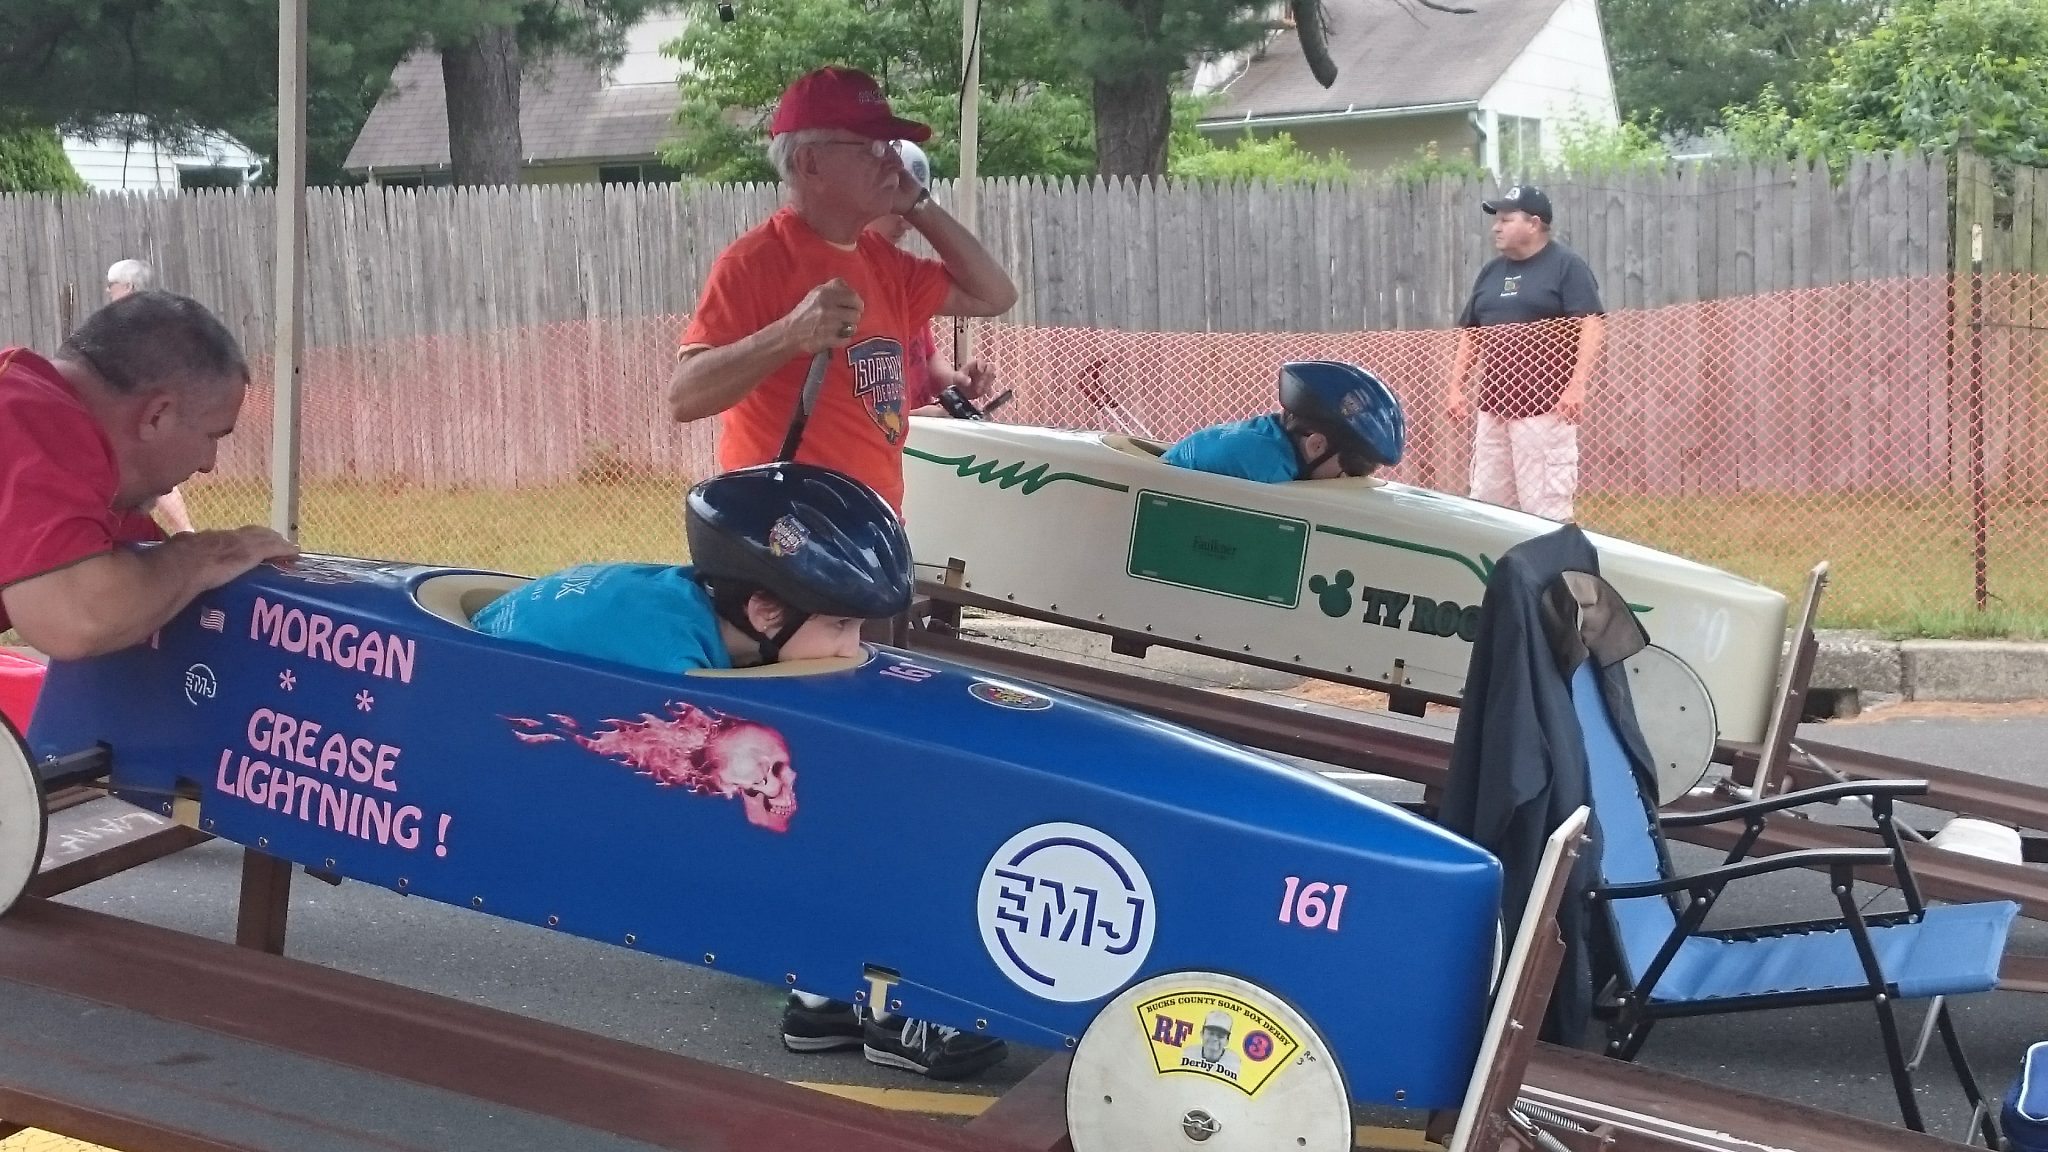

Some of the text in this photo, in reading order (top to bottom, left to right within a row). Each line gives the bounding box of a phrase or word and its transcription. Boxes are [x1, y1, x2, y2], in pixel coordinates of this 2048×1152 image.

[250, 596, 415, 683] MORGAN
[185, 668, 217, 699] EMJ
[248, 708, 401, 792] GREASE
[216, 749, 421, 851] LIGHTNING
[994, 868, 1145, 956] EMJ
[1278, 876, 1348, 932] 161
[1146, 996, 1291, 1046] BUCKS COUNTY SOAP BOX DERBY
[1152, 1013, 1194, 1047] RF
[1180, 1056, 1238, 1081] Derby Don
